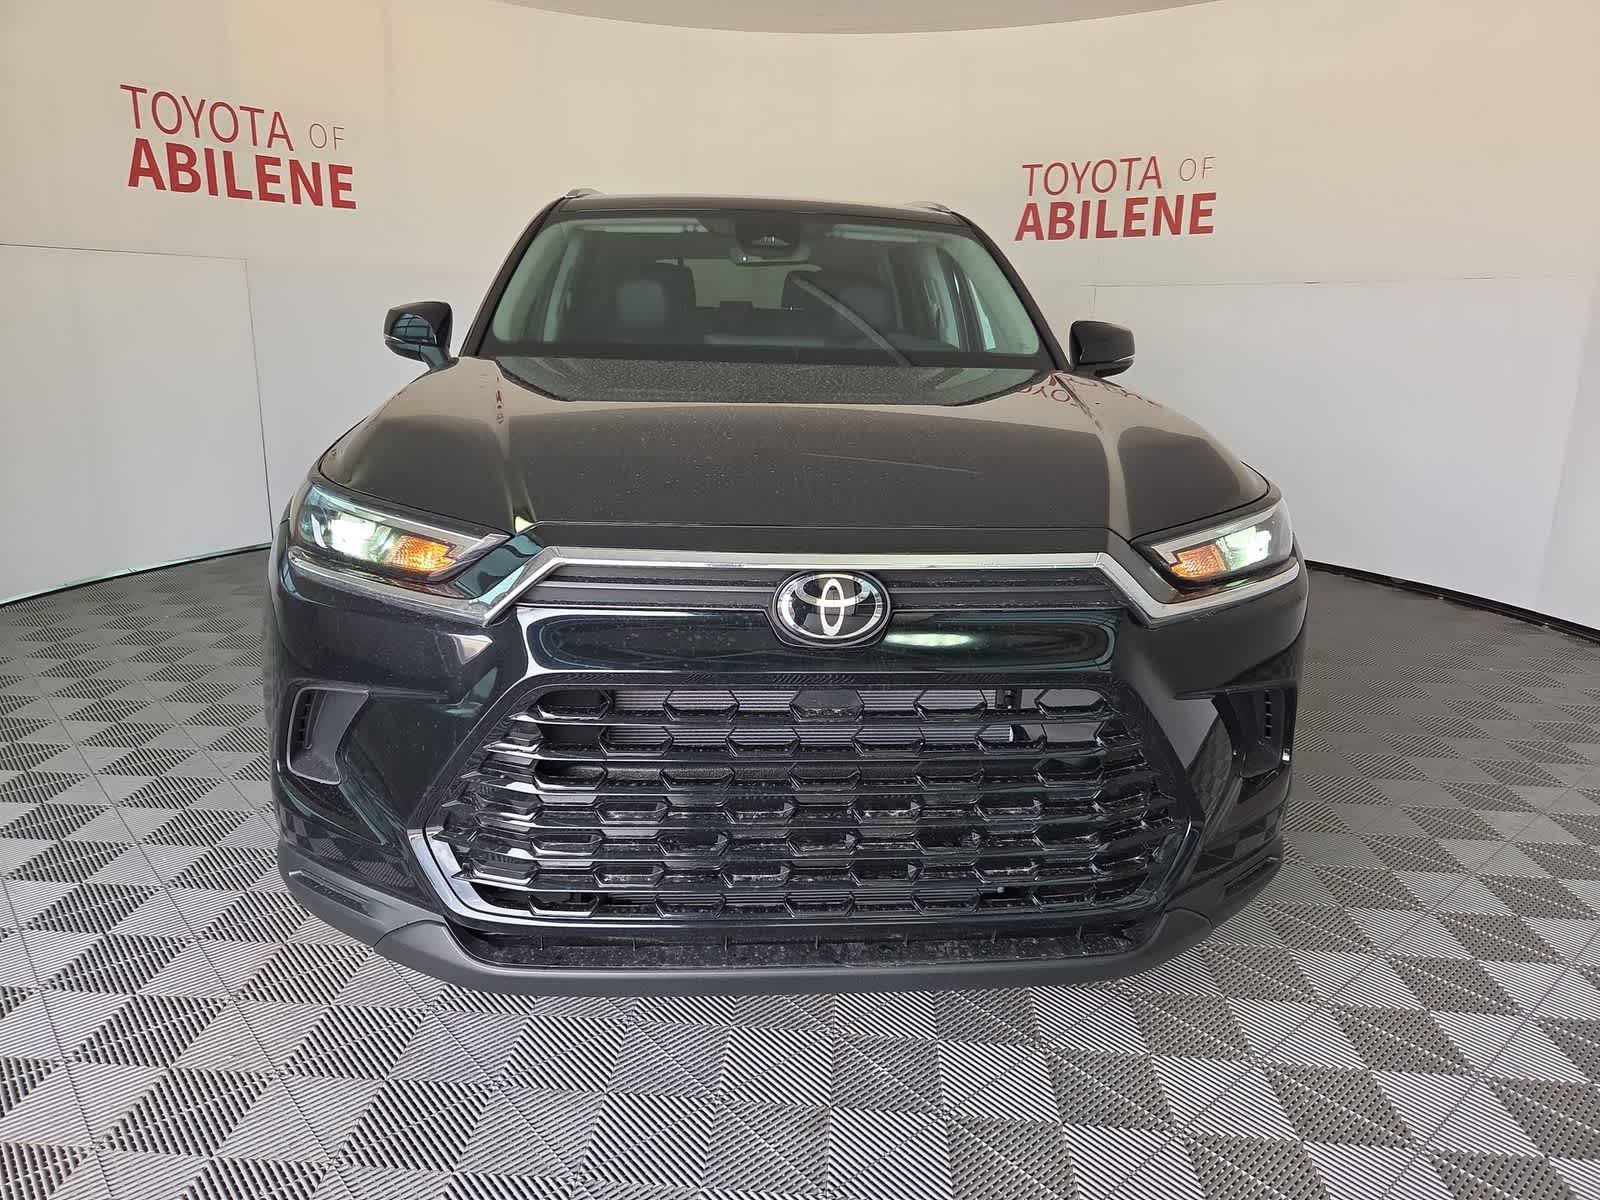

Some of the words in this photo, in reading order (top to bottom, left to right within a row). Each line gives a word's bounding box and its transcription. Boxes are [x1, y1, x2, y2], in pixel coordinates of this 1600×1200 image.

[119, 84, 294, 151] TOYOTA
[309, 123, 345, 150] OF
[128, 137, 357, 209] ABILENE
[1022, 156, 1162, 196] TOYOTA
[1179, 156, 1217, 181] OF
[1014, 192, 1217, 241] ABILENE
